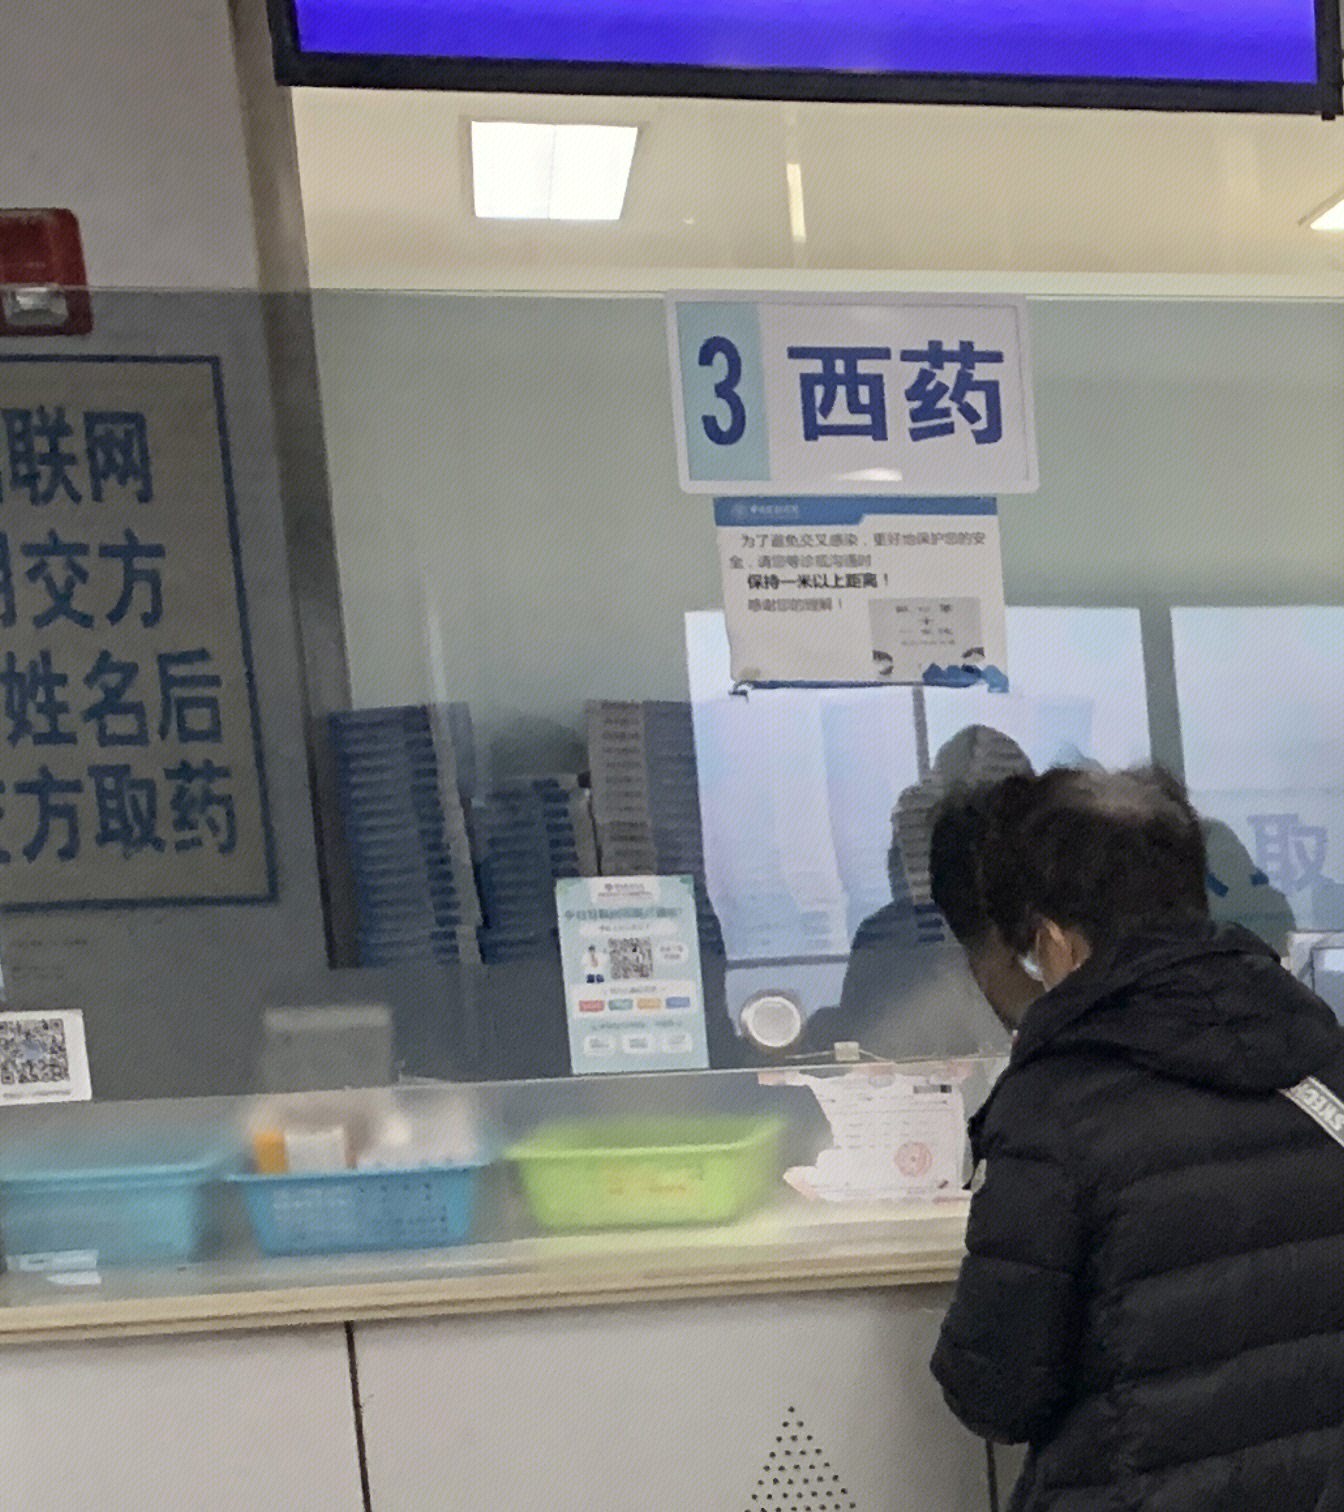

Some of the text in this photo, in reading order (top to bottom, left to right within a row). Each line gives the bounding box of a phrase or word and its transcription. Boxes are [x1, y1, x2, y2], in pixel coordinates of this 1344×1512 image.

[698, 336, 1004, 446] 3 西药
[0, 758, 238, 865] 方取药
